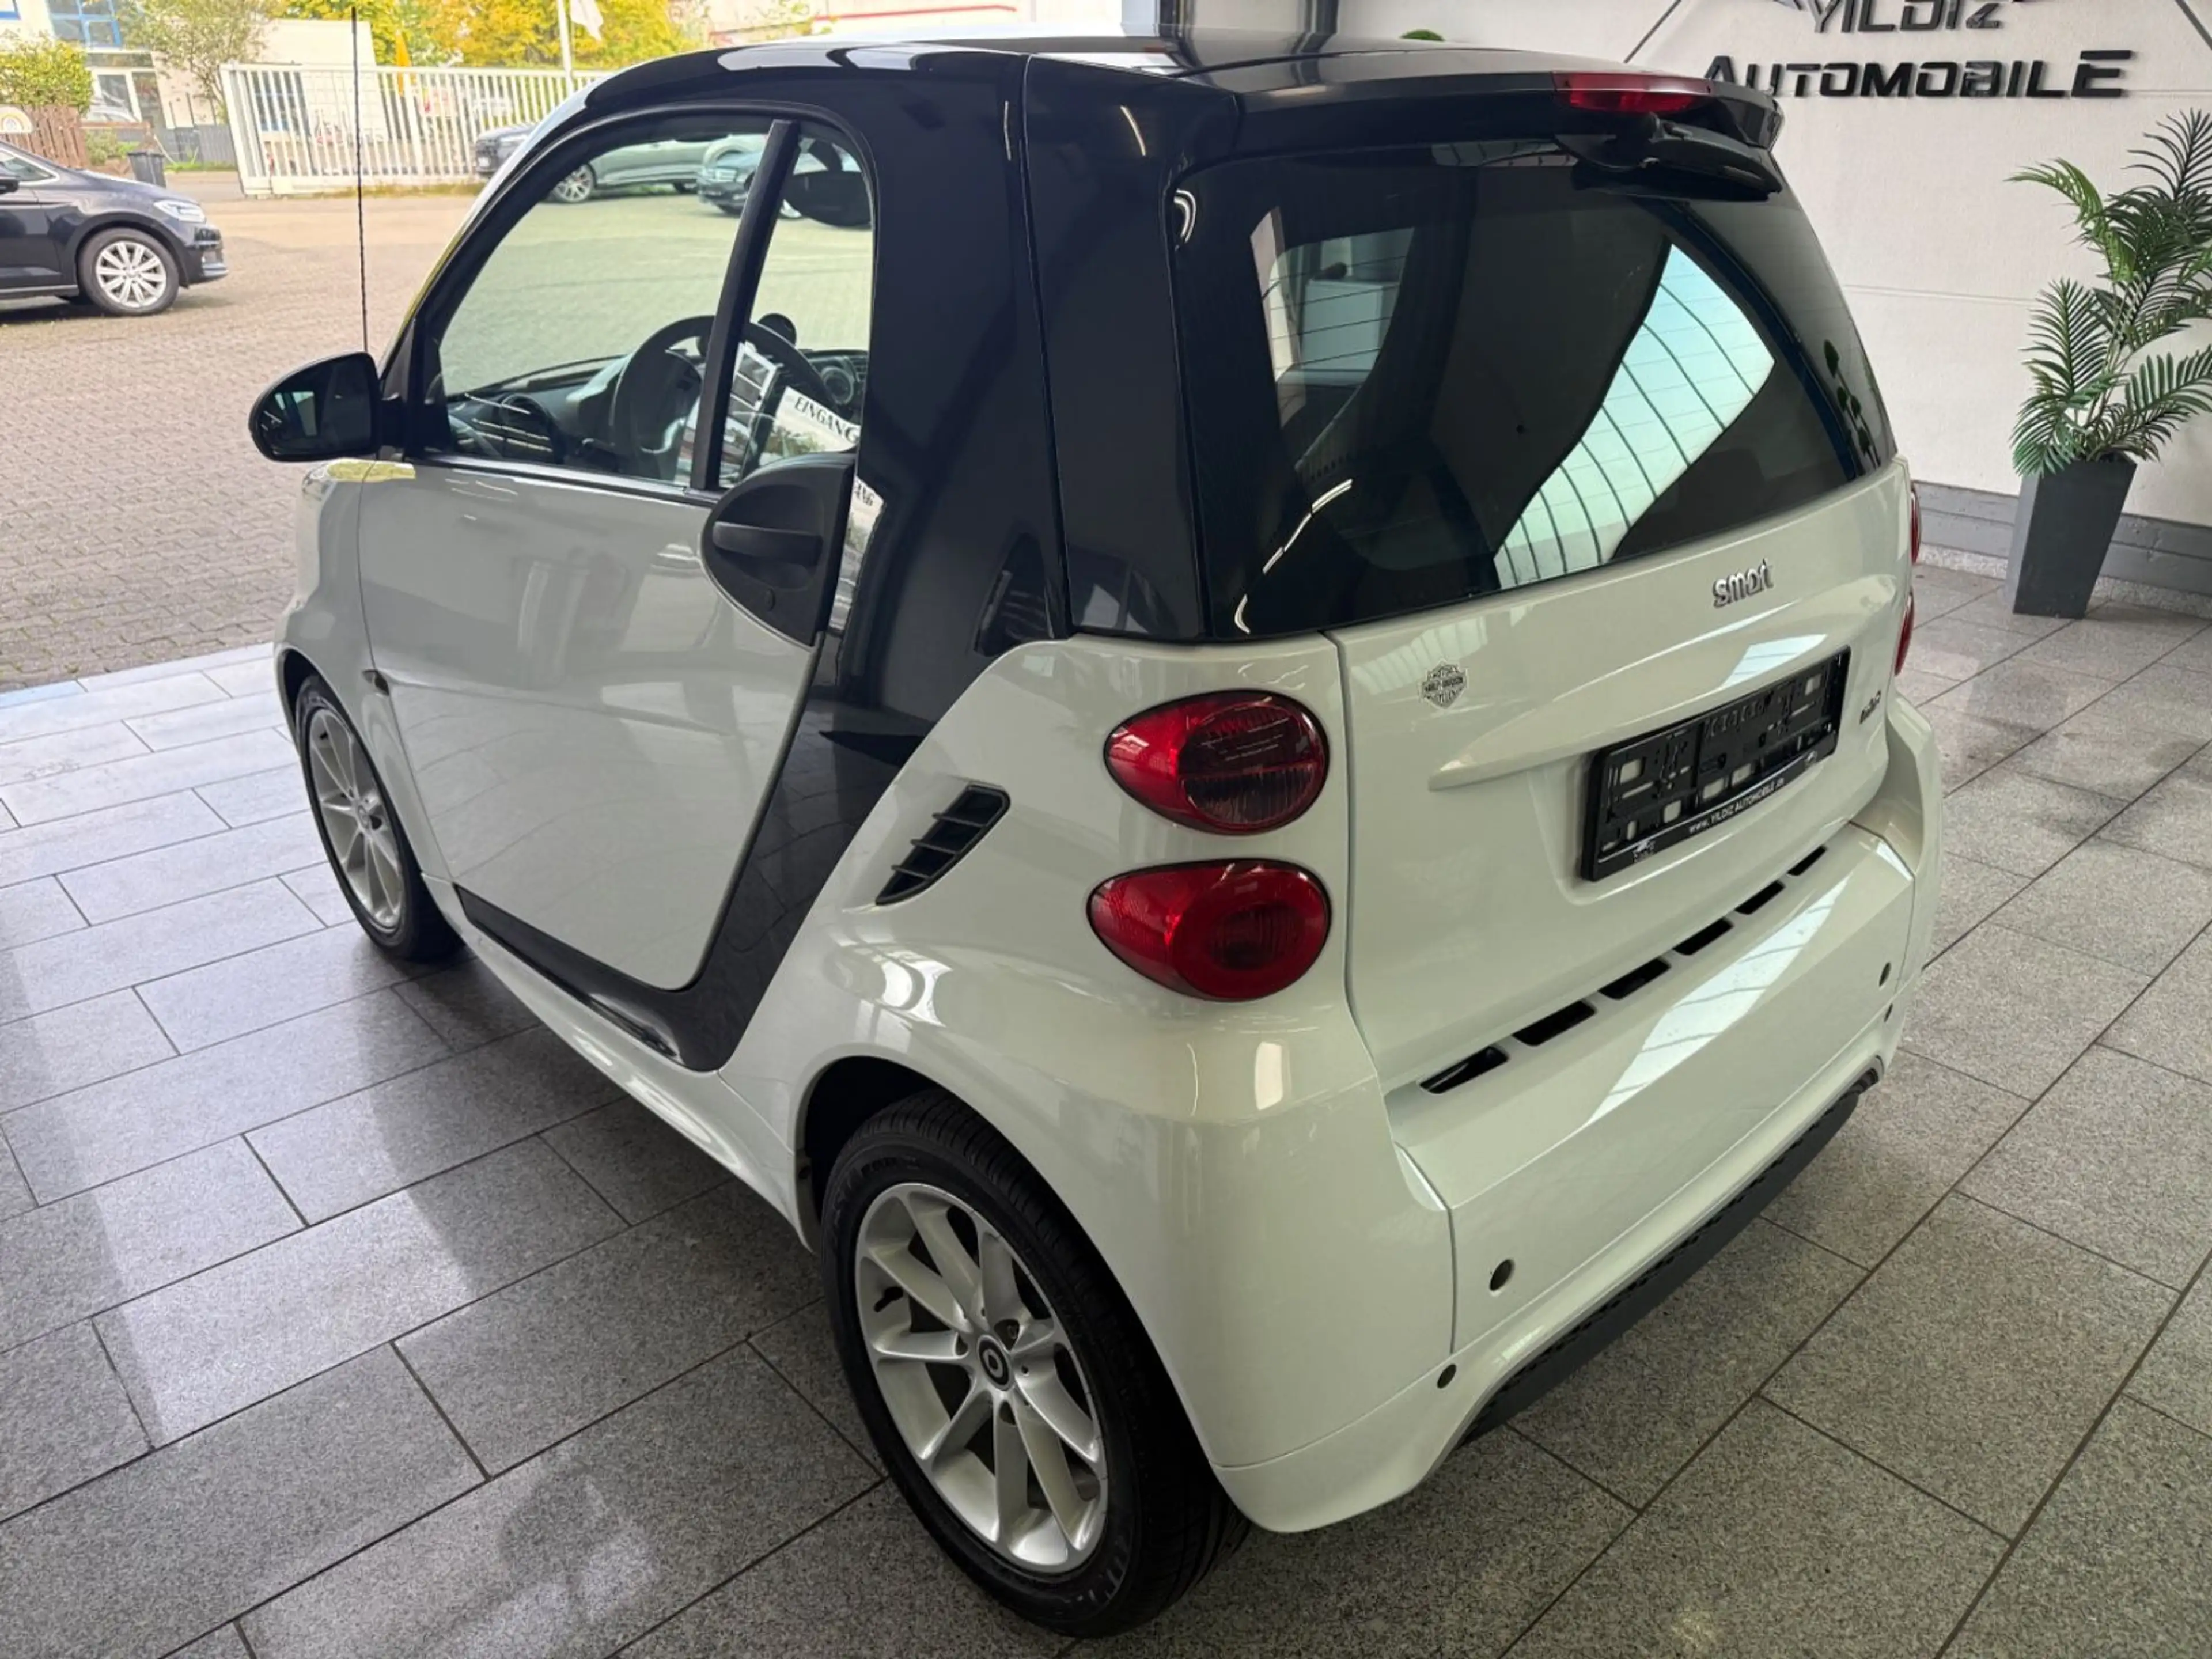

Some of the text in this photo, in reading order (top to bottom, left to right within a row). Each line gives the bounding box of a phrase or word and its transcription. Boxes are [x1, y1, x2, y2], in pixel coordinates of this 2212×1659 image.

[1703, 50, 2133, 97] AUTOMOBILE
[794, 396, 859, 444] EINGANG
[1713, 558, 1774, 609] smart
